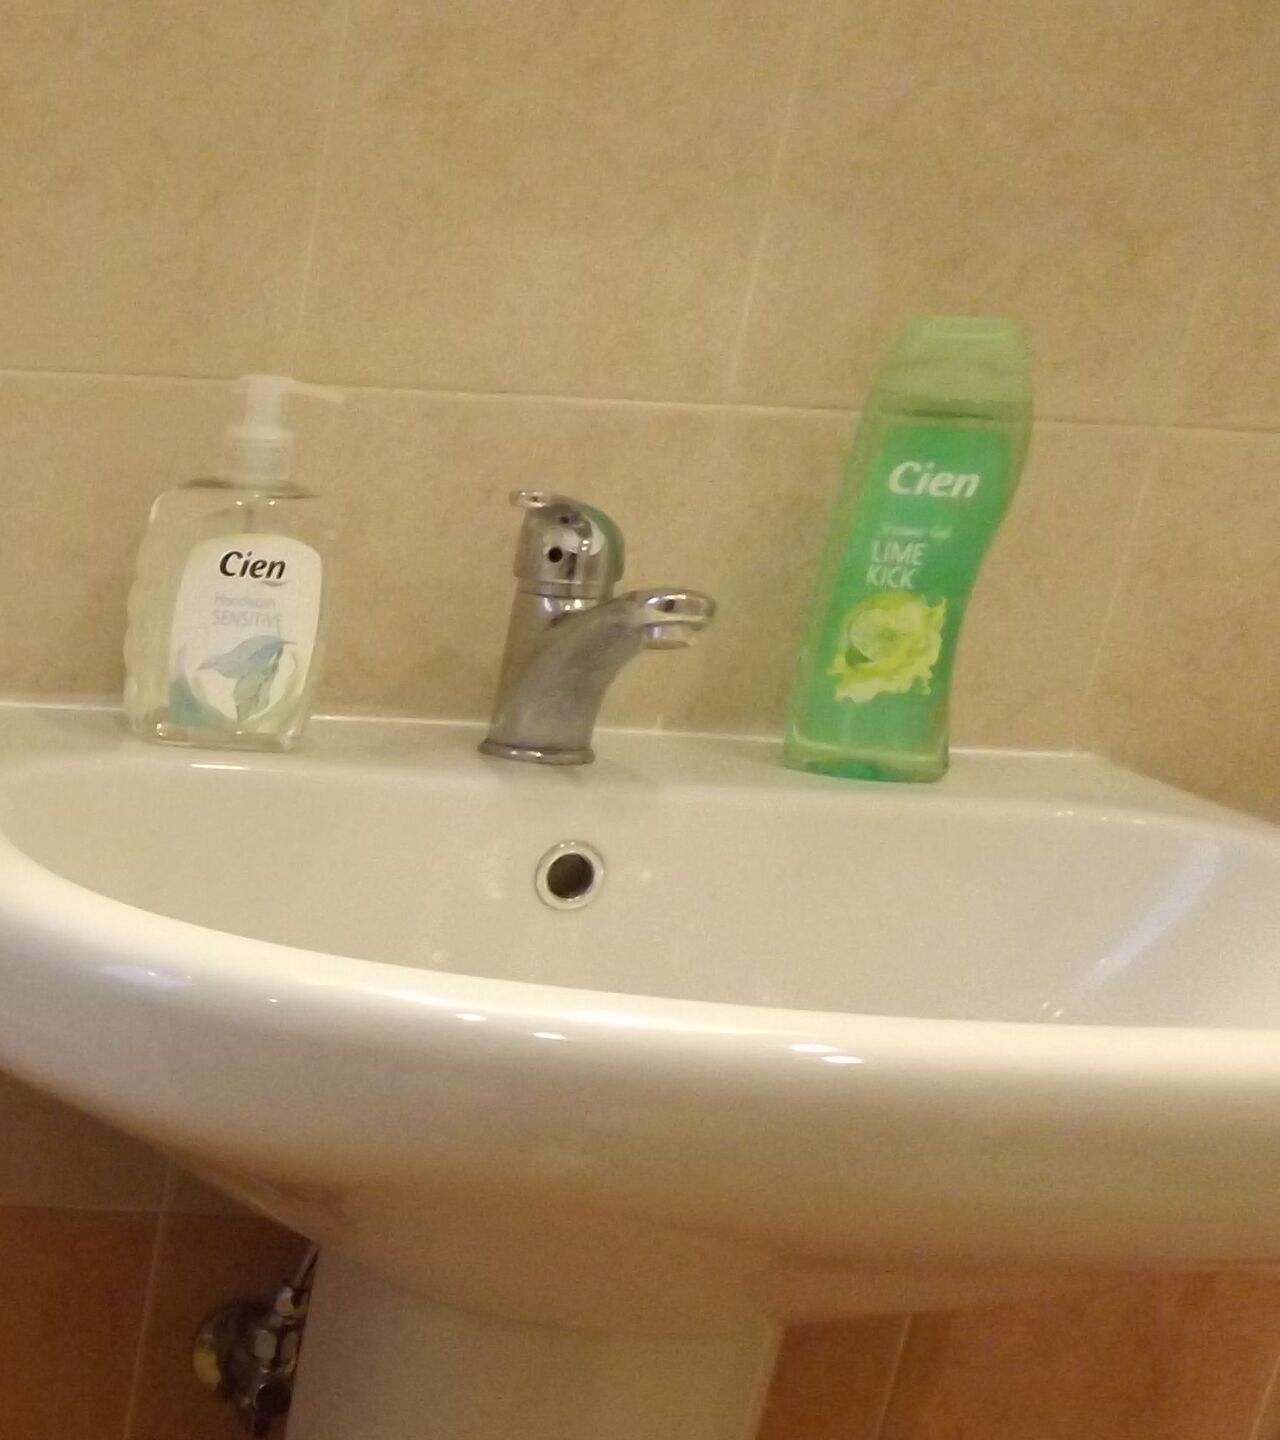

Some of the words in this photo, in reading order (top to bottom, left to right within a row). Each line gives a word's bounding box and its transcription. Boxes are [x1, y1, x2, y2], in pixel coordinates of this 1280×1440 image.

[888, 461, 981, 498] Cien
[219, 551, 286, 579] Cien
[871, 540, 927, 566] LIME
[866, 564, 918, 589] KICK
